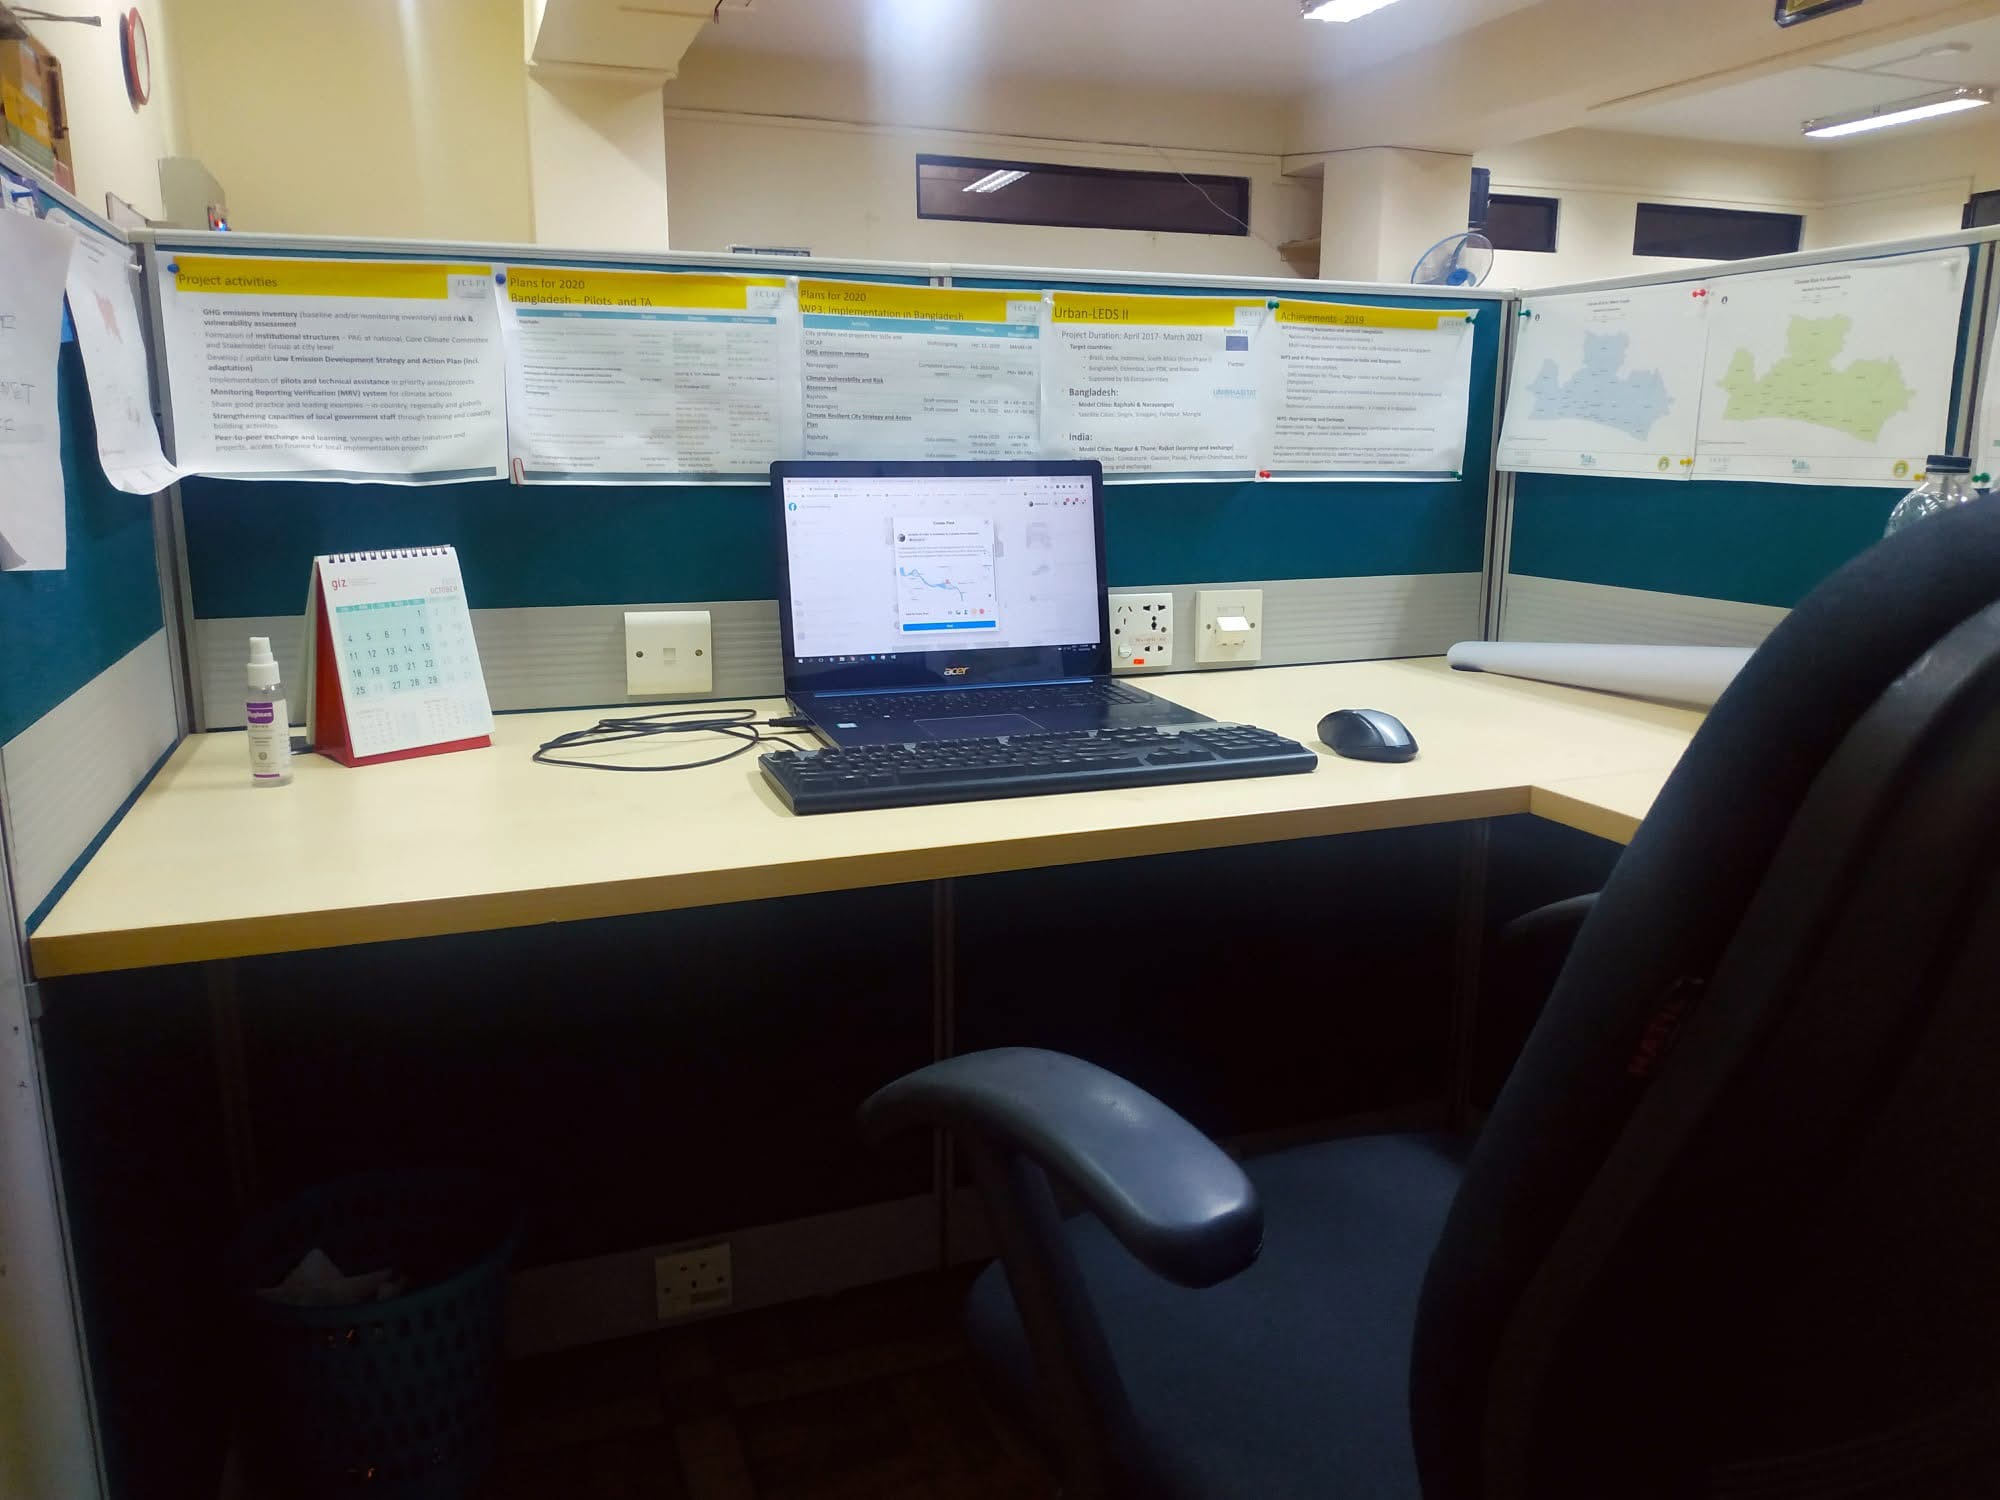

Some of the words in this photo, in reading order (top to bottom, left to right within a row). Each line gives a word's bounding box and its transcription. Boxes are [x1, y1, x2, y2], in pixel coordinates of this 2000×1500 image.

[179, 274, 221, 287] Project
[225, 277, 278, 287] activities
[510, 277, 538, 288] Plans
[541, 278, 555, 288] for
[560, 280, 585, 289] 2020
[511, 293, 571, 305] Bangladesh
[584, 296, 612, 305] Pilots
[618, 297, 636, 306] and
[640, 298, 652, 306] TA
[800, 289, 824, 299] Plans
[828, 291, 840, 300] for
[843, 292, 866, 302] 2020
[262, 311, 297, 319] inventory
[334, 312, 360, 320] and/or
[360, 313, 399, 321] monitoring
[801, 304, 826, 313] WP3:
[828, 306, 903, 318] Implementation
[915, 311, 963, 322] Bangladesh
[1054, 307, 1118, 319] Urban-LEDS
[1123, 309, 1128, 320] II
[1282, 312, 1336, 323] Achievements
[1344, 315, 1364, 324] 2019
[1062, 330, 1086, 339] Project
[1089, 331, 1119, 339] Duration:
[1123, 332, 1139, 340] April
[376, 357, 405, 365] Strategy
[210, 388, 253, 396] Monitoring
[255, 389, 292, 397] Reporting
[1069, 388, 1118, 397] Bangladesh:
[331, 578, 347, 591] giz
[430, 585, 457, 594] OCTOBER
[402, 628, 407, 636] 7
[350, 652, 358, 660] 11
[368, 650, 376, 658] 12
[386, 647, 395, 655] 13
[404, 645, 413, 654] 14
[422, 643, 430, 651] 15
[353, 669, 361, 678] 18
[371, 667, 380, 675] 19
[389, 664, 398, 672] 20
[408, 662, 416, 670] 21
[425, 659, 433, 668] 22
[944, 667, 970, 676] acer
[356, 686, 365, 695] 25
[392, 681, 400, 689] 27
[410, 678, 419, 687] 28
[428, 676, 437, 684] 29
